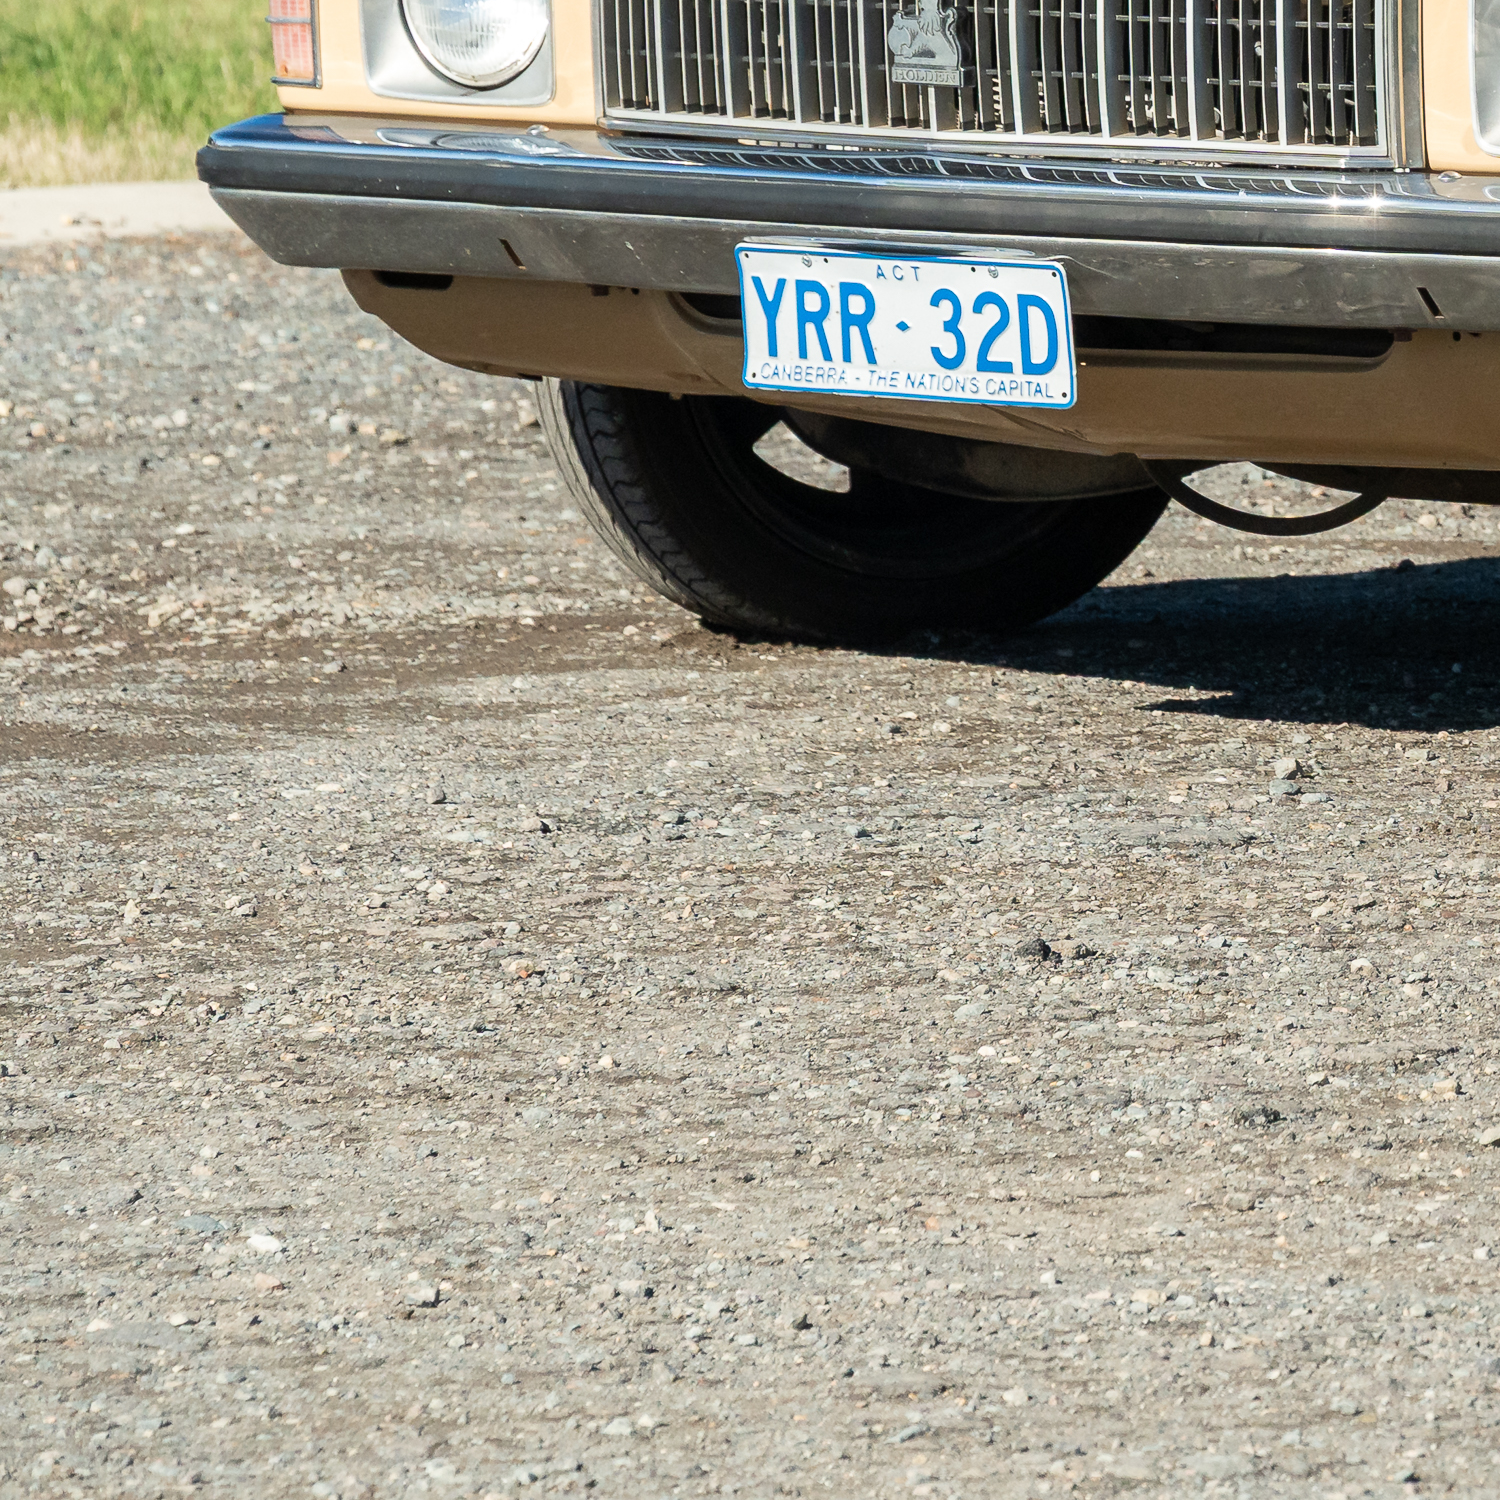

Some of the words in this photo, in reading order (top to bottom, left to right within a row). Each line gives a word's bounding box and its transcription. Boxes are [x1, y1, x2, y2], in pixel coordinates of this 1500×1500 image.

[894, 68, 957, 83] HOLDEN
[876, 264, 921, 282] ACT
[751, 275, 878, 365] YRR
[929, 287, 1059, 376] 32D
[760, 362, 848, 385] CANBERRA
[868, 369, 901, 388] THE
[904, 372, 980, 395] NATION'S
[985, 378, 1054, 399] CAPITAL
